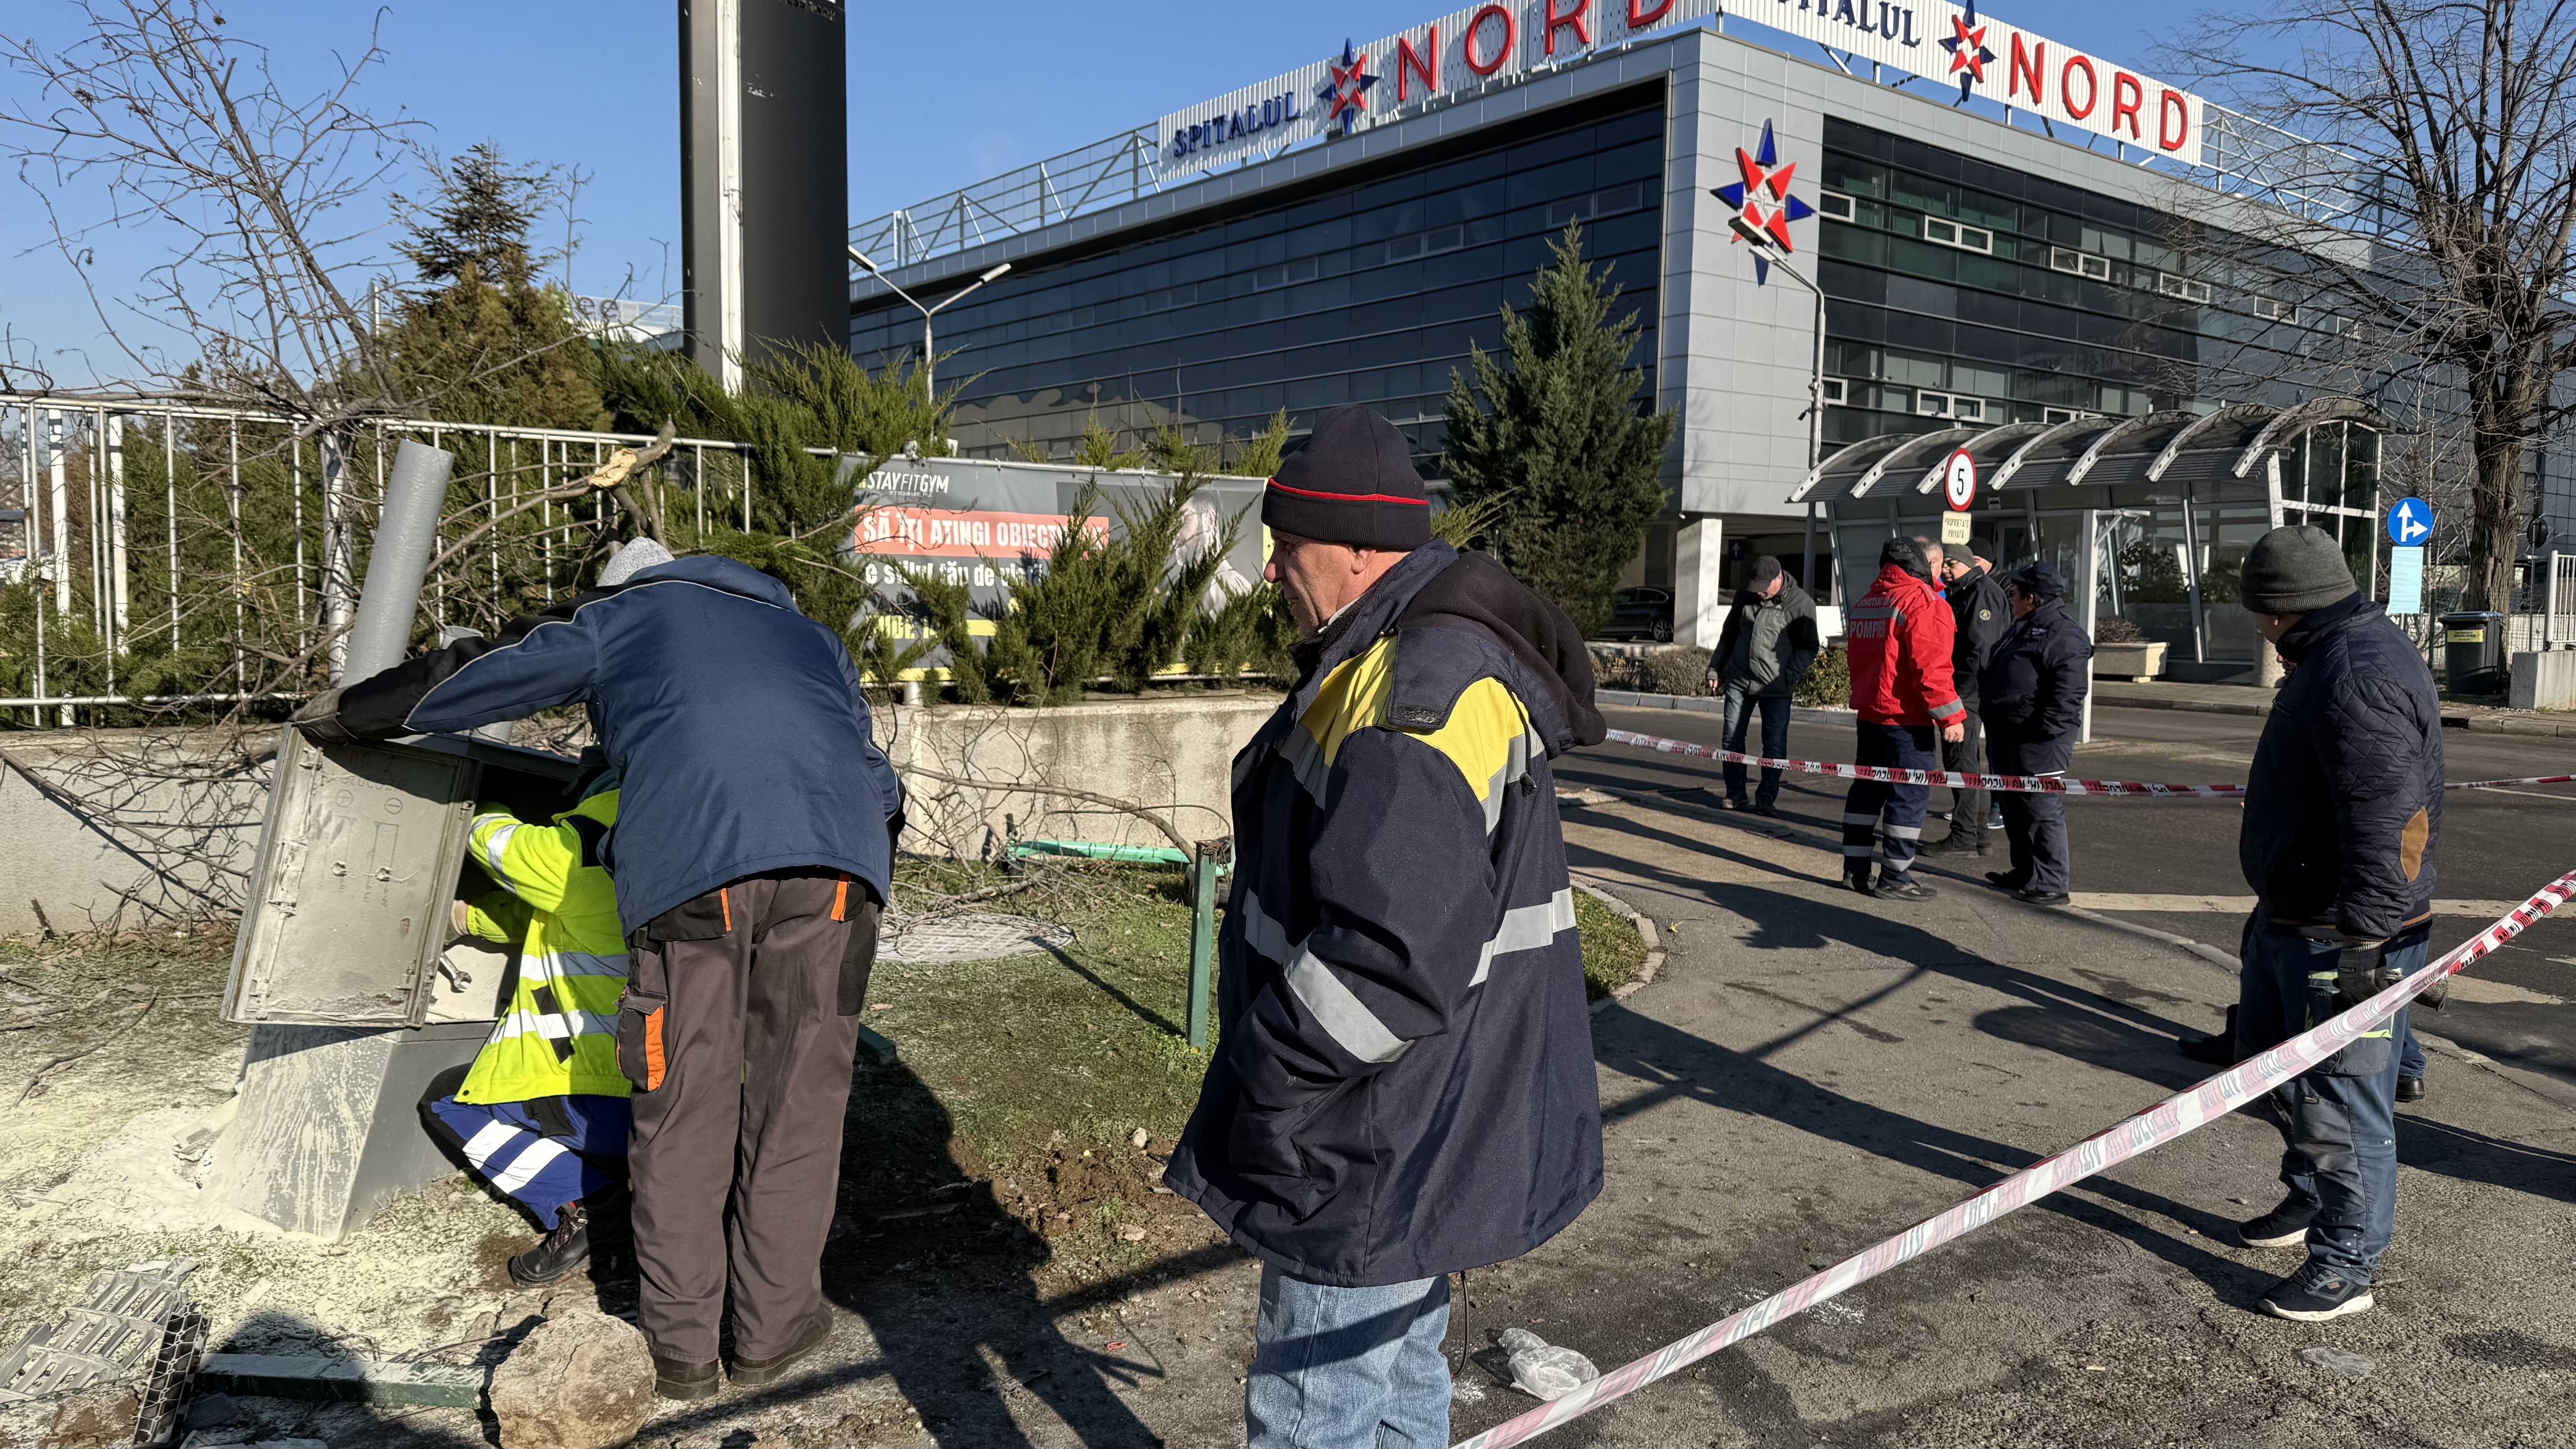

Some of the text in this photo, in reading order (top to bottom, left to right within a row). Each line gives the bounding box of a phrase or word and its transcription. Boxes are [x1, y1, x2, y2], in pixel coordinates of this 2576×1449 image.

[2009, 32, 2188, 151] NORD
[1173, 92, 1301, 158] SPITALUL
[1957, 468, 1964, 496] 5
[864, 510, 891, 542] SĂ
[930, 519, 990, 547] ATINGI
[974, 563, 994, 586] de
